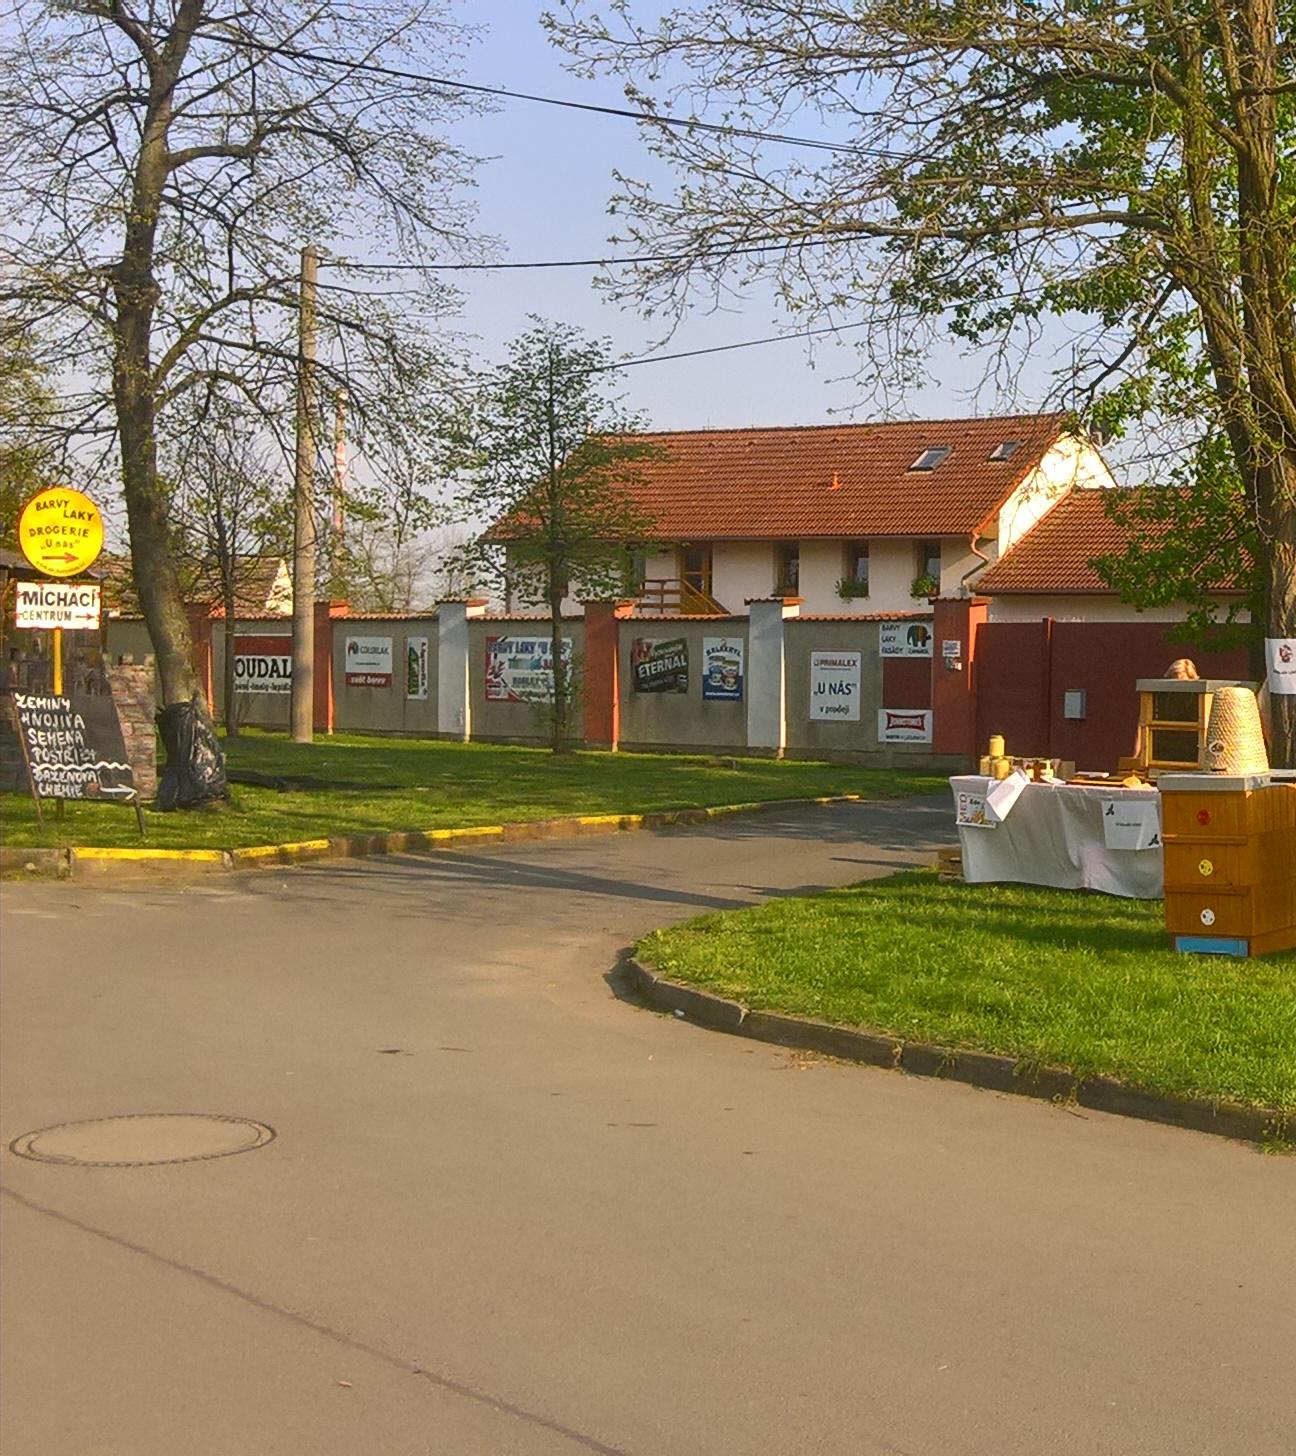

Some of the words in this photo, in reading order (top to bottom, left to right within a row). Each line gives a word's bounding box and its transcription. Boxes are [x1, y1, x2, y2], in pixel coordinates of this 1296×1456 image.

[35, 499, 70, 511] BARVY
[63, 510, 95, 521] LAKY
[28, 525, 90, 538] DROGERIE
[22, 610, 72, 621] CENTRUM
[235, 658, 292, 678] OUDAL
[638, 654, 688, 679] ETERNAL
[15, 692, 71, 712] ZEMINY
[21, 713, 86, 730] HNOJIVA
[28, 727, 85, 747] SEMENA
[38, 783, 83, 797] CHEMIE
